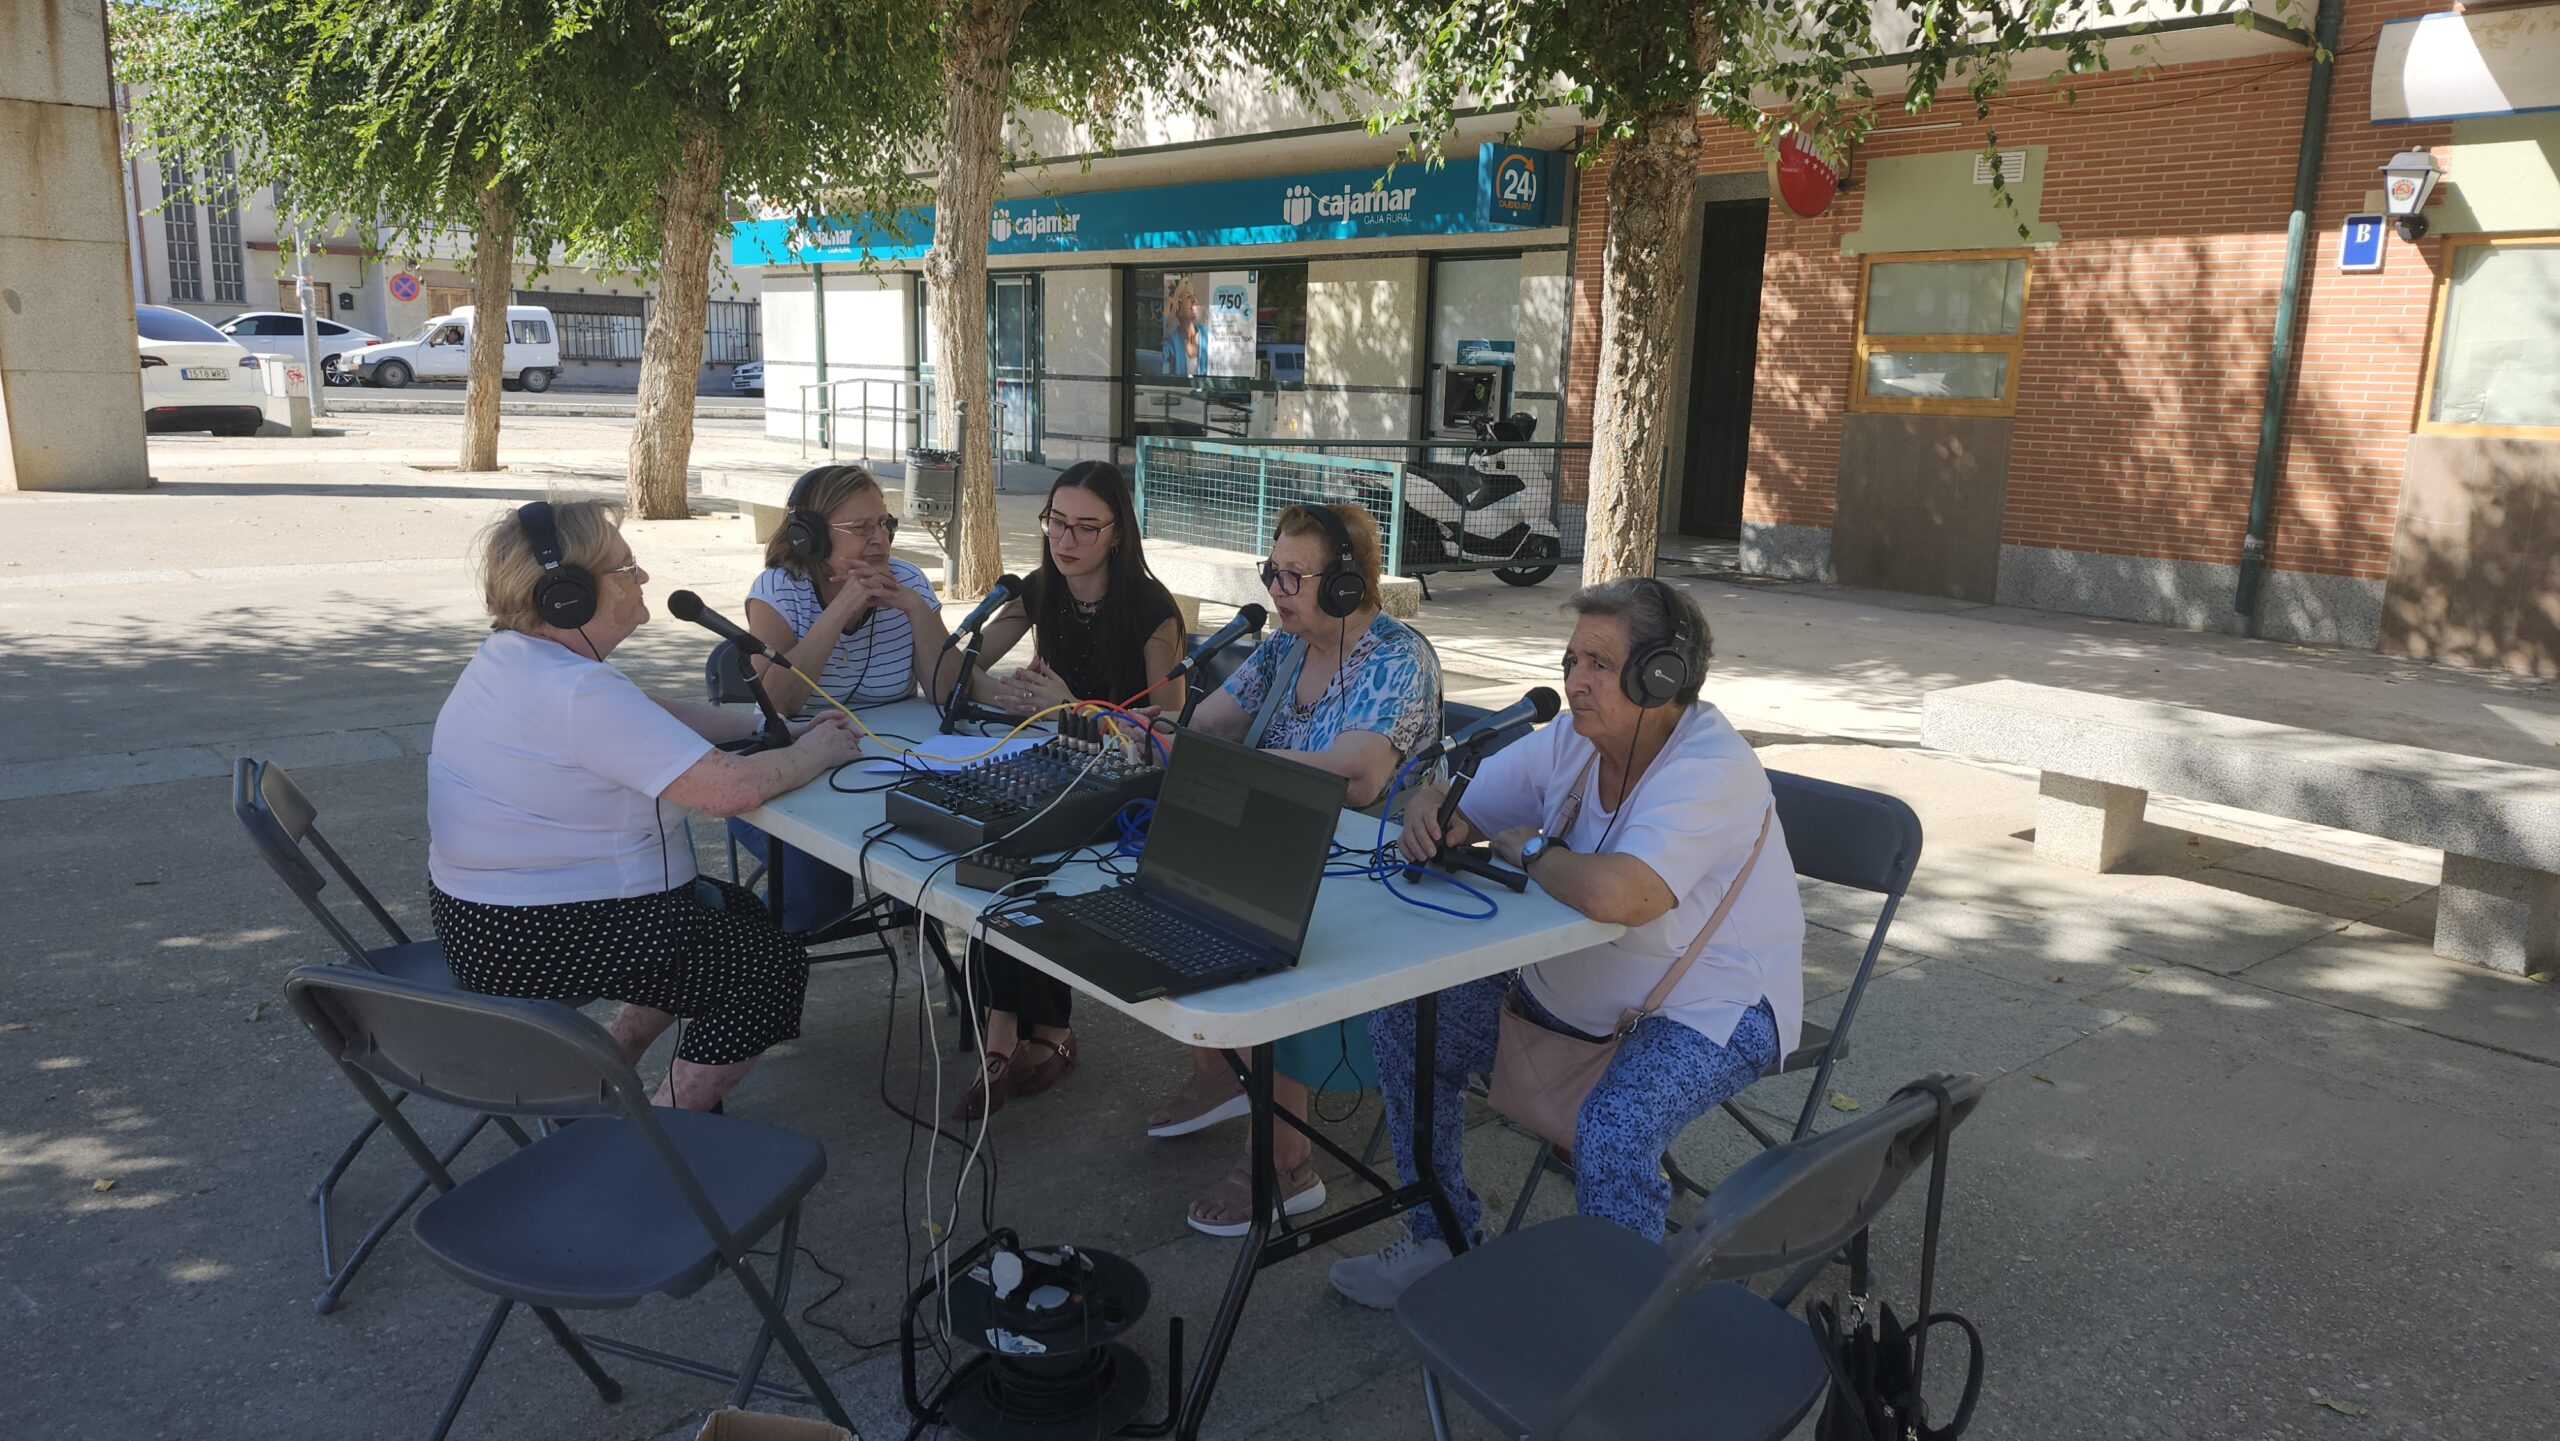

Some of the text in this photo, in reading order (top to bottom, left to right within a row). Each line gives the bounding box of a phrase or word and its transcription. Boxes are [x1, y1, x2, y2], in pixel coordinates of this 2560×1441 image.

[1503, 168, 1532, 201] 24
[1318, 184, 1416, 224] cajamar
[1363, 212, 1413, 225] CAJA RURAL
[2355, 223, 2371, 243] B
